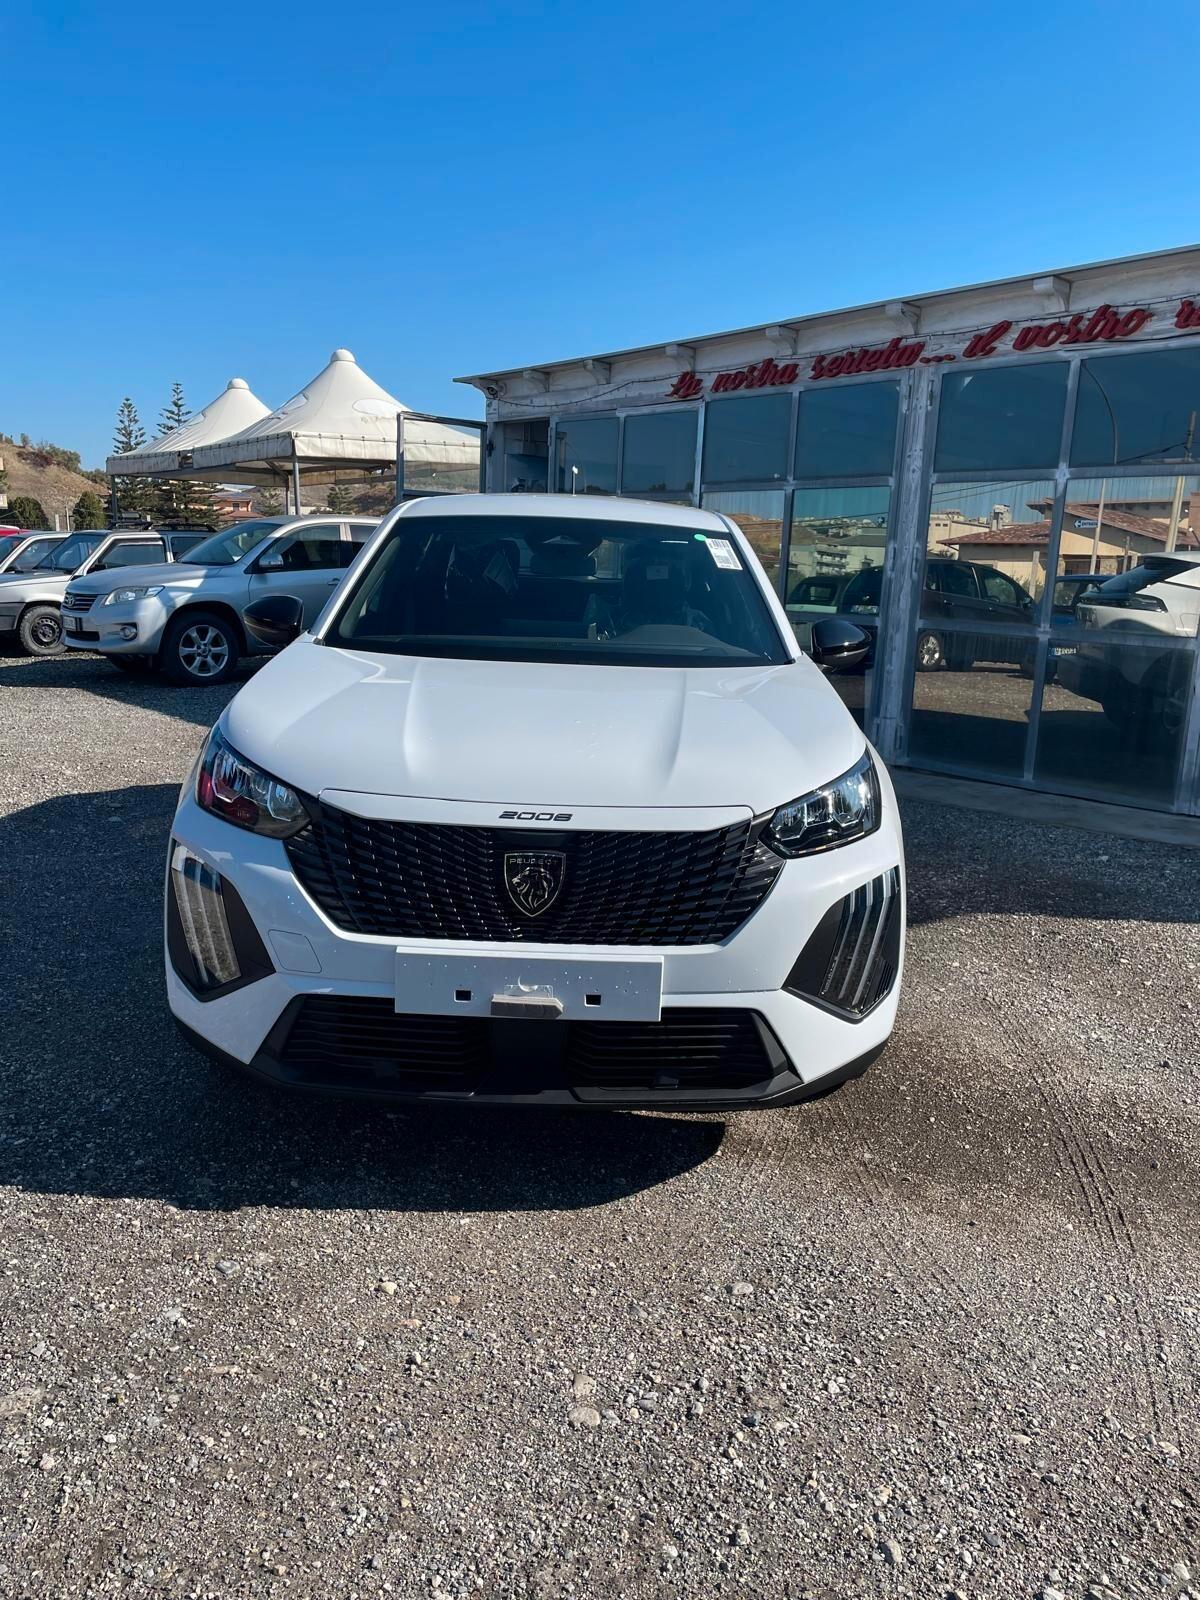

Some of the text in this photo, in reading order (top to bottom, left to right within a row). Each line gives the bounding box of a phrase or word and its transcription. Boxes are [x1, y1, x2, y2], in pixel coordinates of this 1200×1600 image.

[710, 358, 800, 393] nostra
[962, 321, 1013, 358] il
[1012, 304, 1155, 350] vostro
[499, 811, 573, 821] 2008
